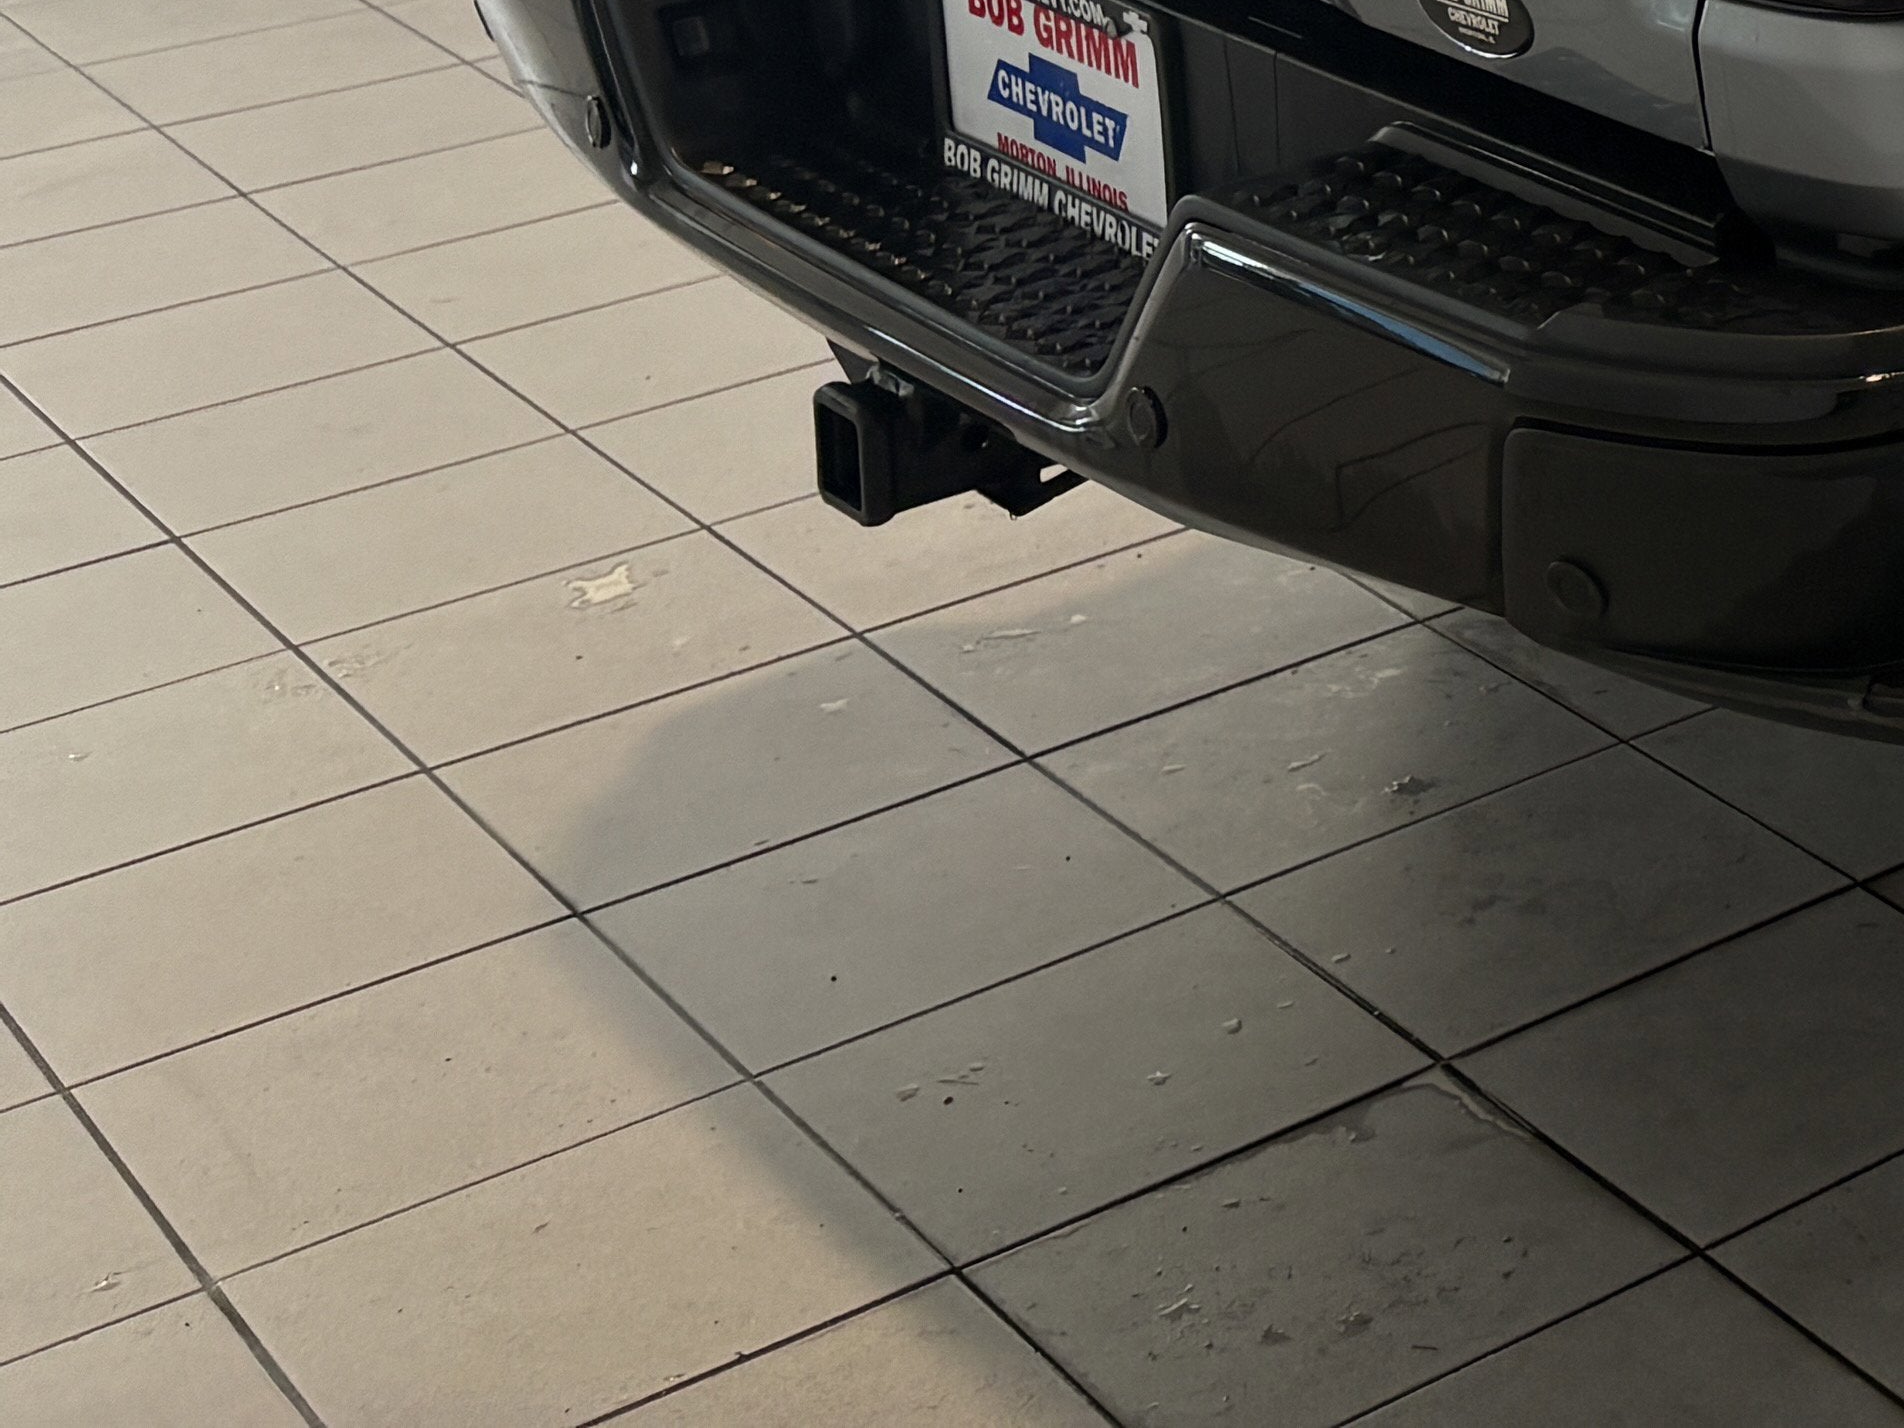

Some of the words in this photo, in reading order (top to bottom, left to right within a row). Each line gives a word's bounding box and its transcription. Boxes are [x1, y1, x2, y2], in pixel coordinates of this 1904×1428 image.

[1033, 4, 1140, 89] GRIMM
[997, 69, 1118, 149] CHEVROLET
[943, 137, 982, 178] BOB
[986, 158, 1049, 210] GRIMM
[1053, 190, 1159, 259] CHEVROLE
[1065, 164, 1129, 212] ILLINOIS
